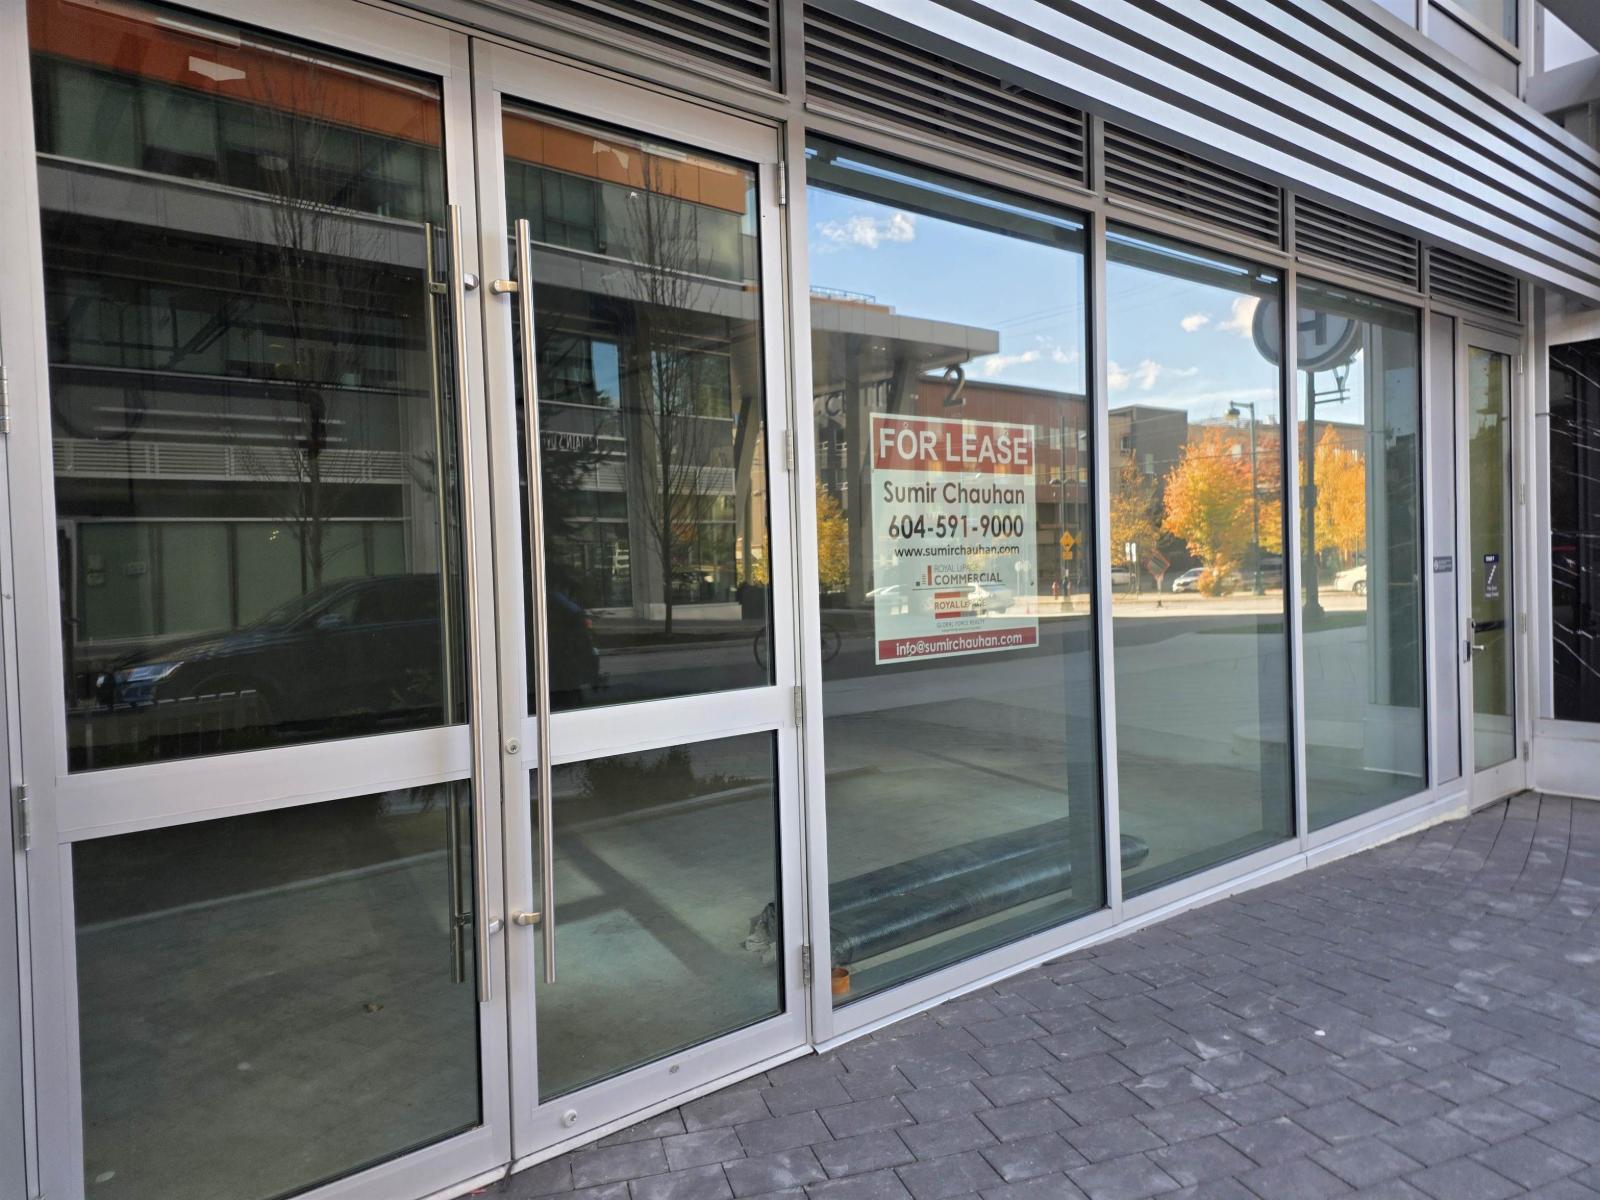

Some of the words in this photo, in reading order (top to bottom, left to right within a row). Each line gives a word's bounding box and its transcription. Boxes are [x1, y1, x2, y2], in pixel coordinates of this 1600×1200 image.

[879, 428, 938, 462] FOR
[945, 432, 1029, 465] LEASE
[883, 480, 936, 504] Sumir
[942, 481, 1025, 505] Chauhan
[888, 514, 1024, 539] 604-591-9000
[894, 543, 1020, 558] www.sumirchauhan.com
[934, 572, 1003, 586] COMMERCIAL
[934, 601, 959, 611] ROYAL
[896, 633, 1023, 657] info@sumirchauhan.com
